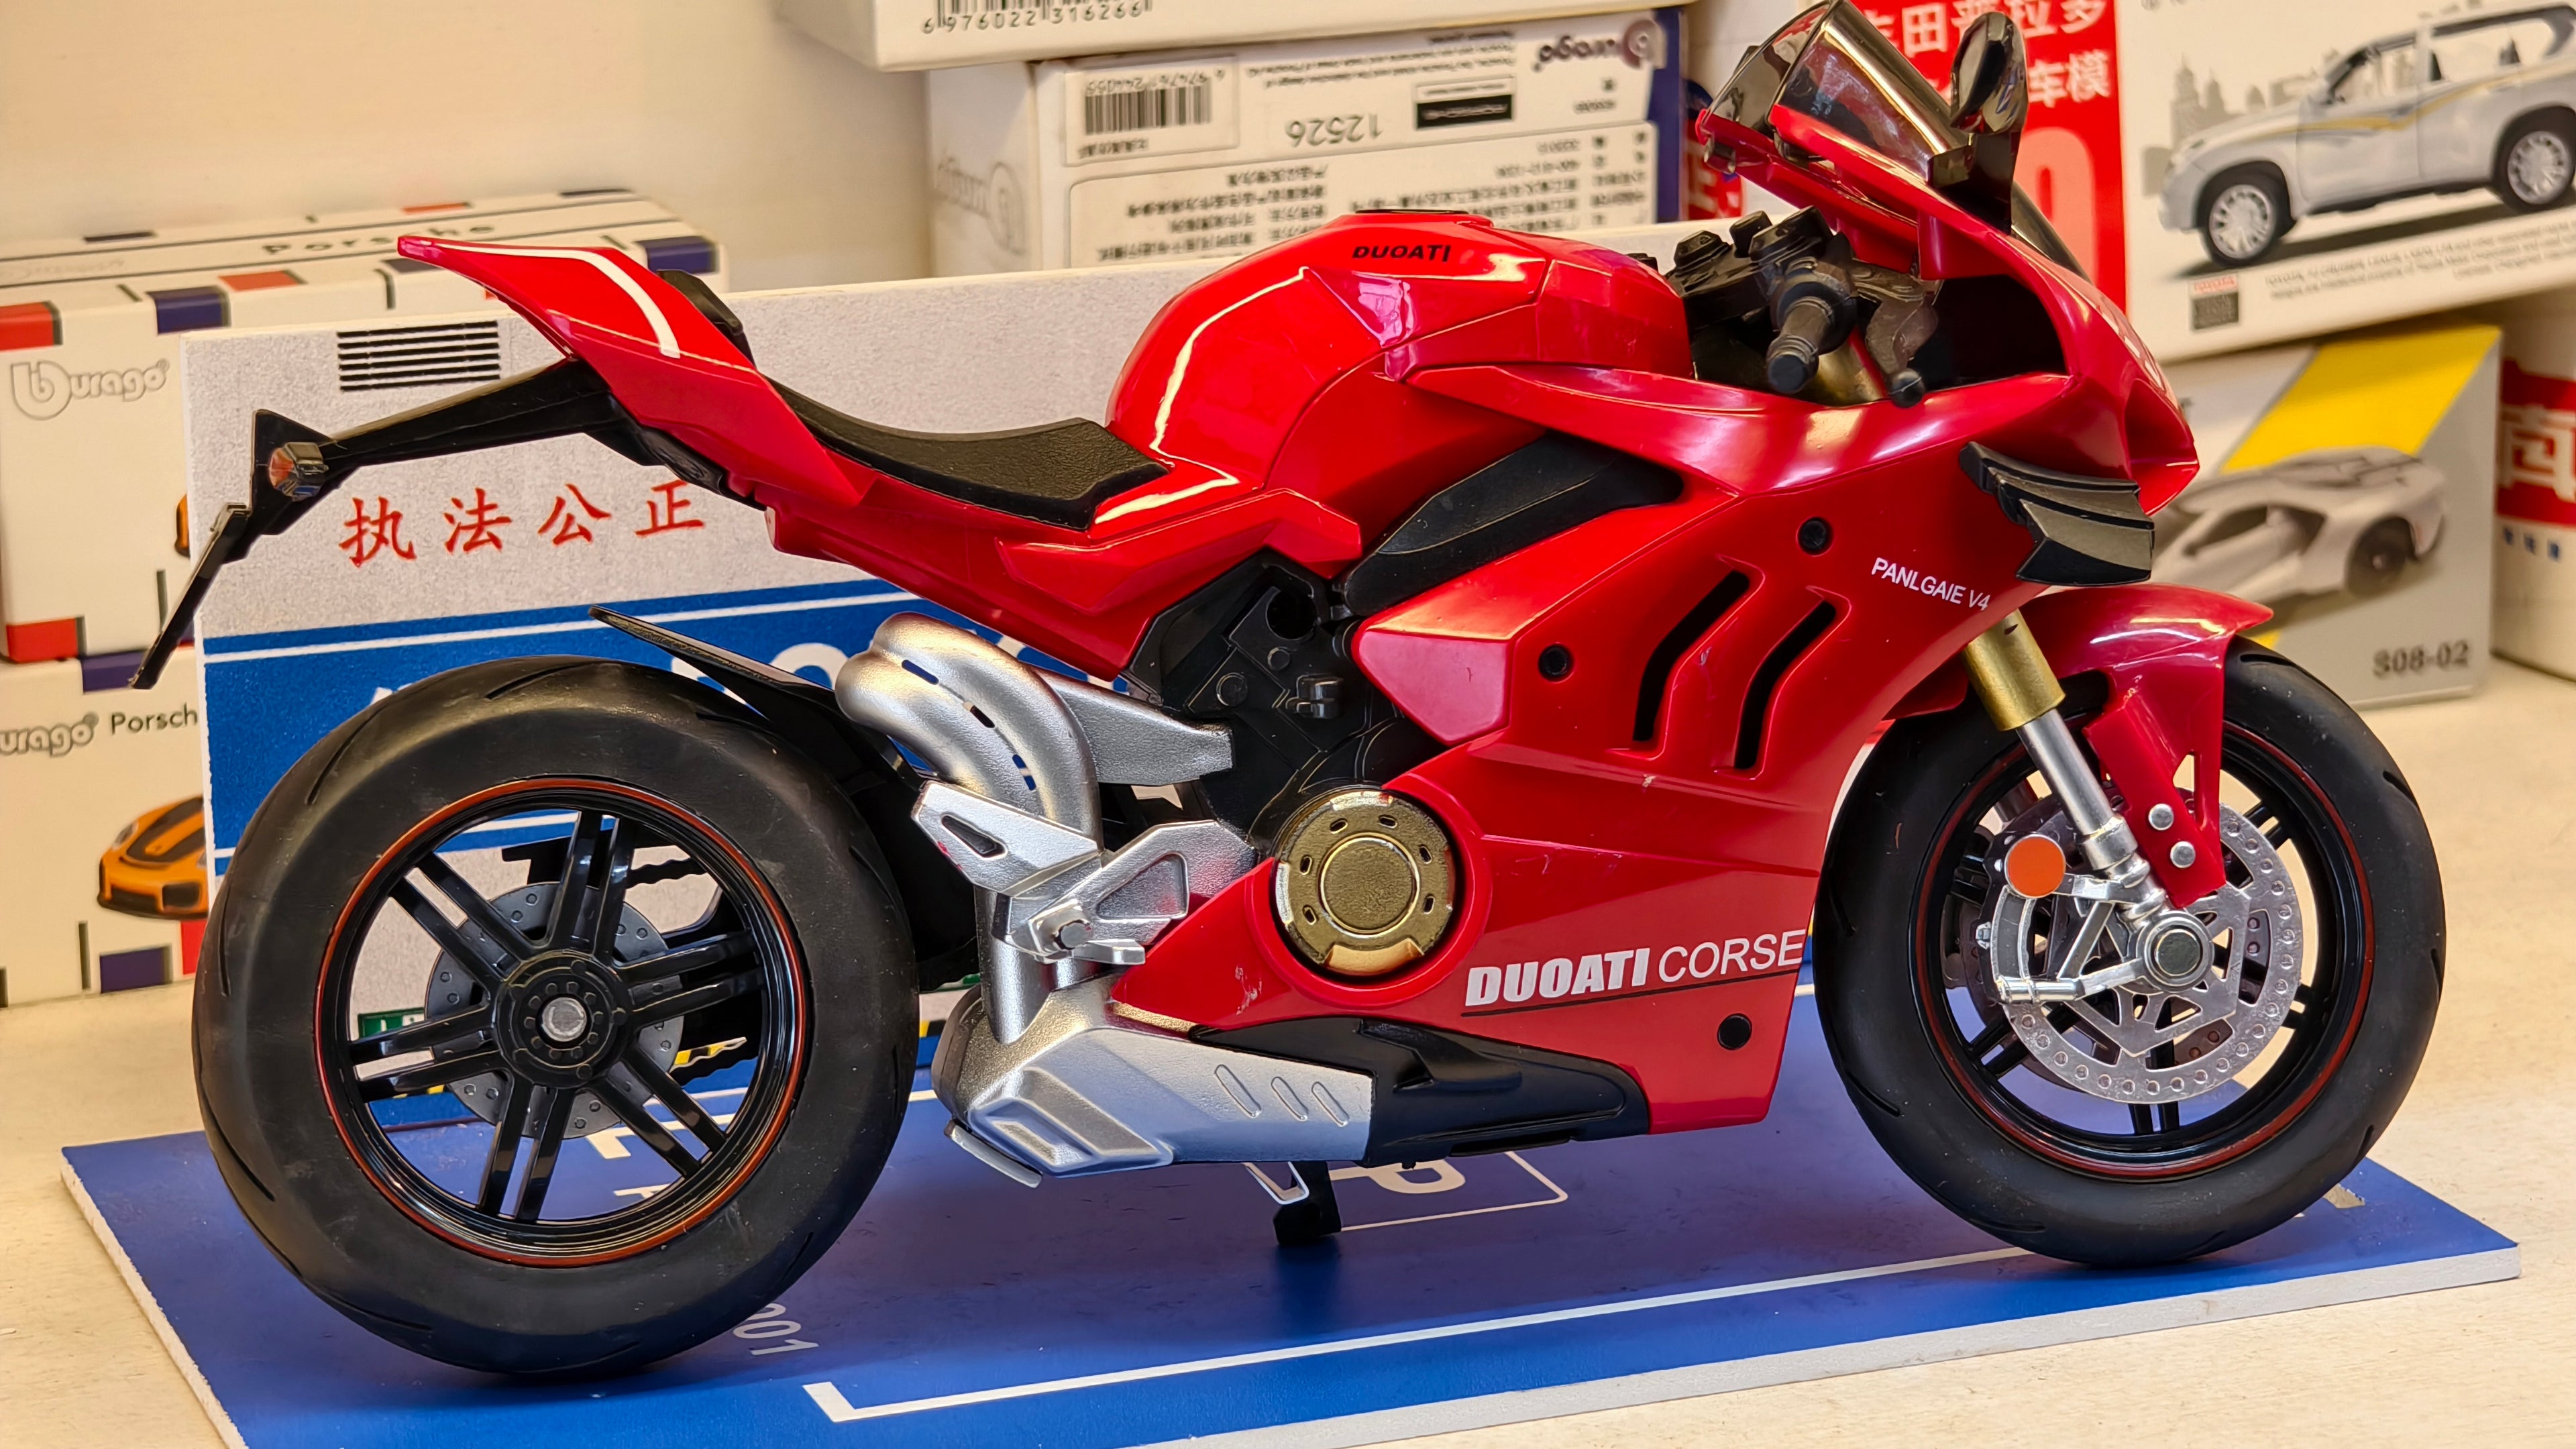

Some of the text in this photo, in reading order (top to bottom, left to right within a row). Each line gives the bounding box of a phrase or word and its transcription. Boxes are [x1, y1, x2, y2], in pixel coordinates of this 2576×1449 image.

[945, 10, 1036, 33] 976022
[1051, 2, 1143, 25] 316266
[1286, 113, 1383, 148] 12526
[1352, 244, 1452, 263] DUOATI
[338, 478, 705, 568] 执法公正
[1871, 557, 1991, 611] PANLGAIE V4
[111, 702, 199, 735] Porsch
[1465, 928, 1806, 1006] DUOATI CORSE
